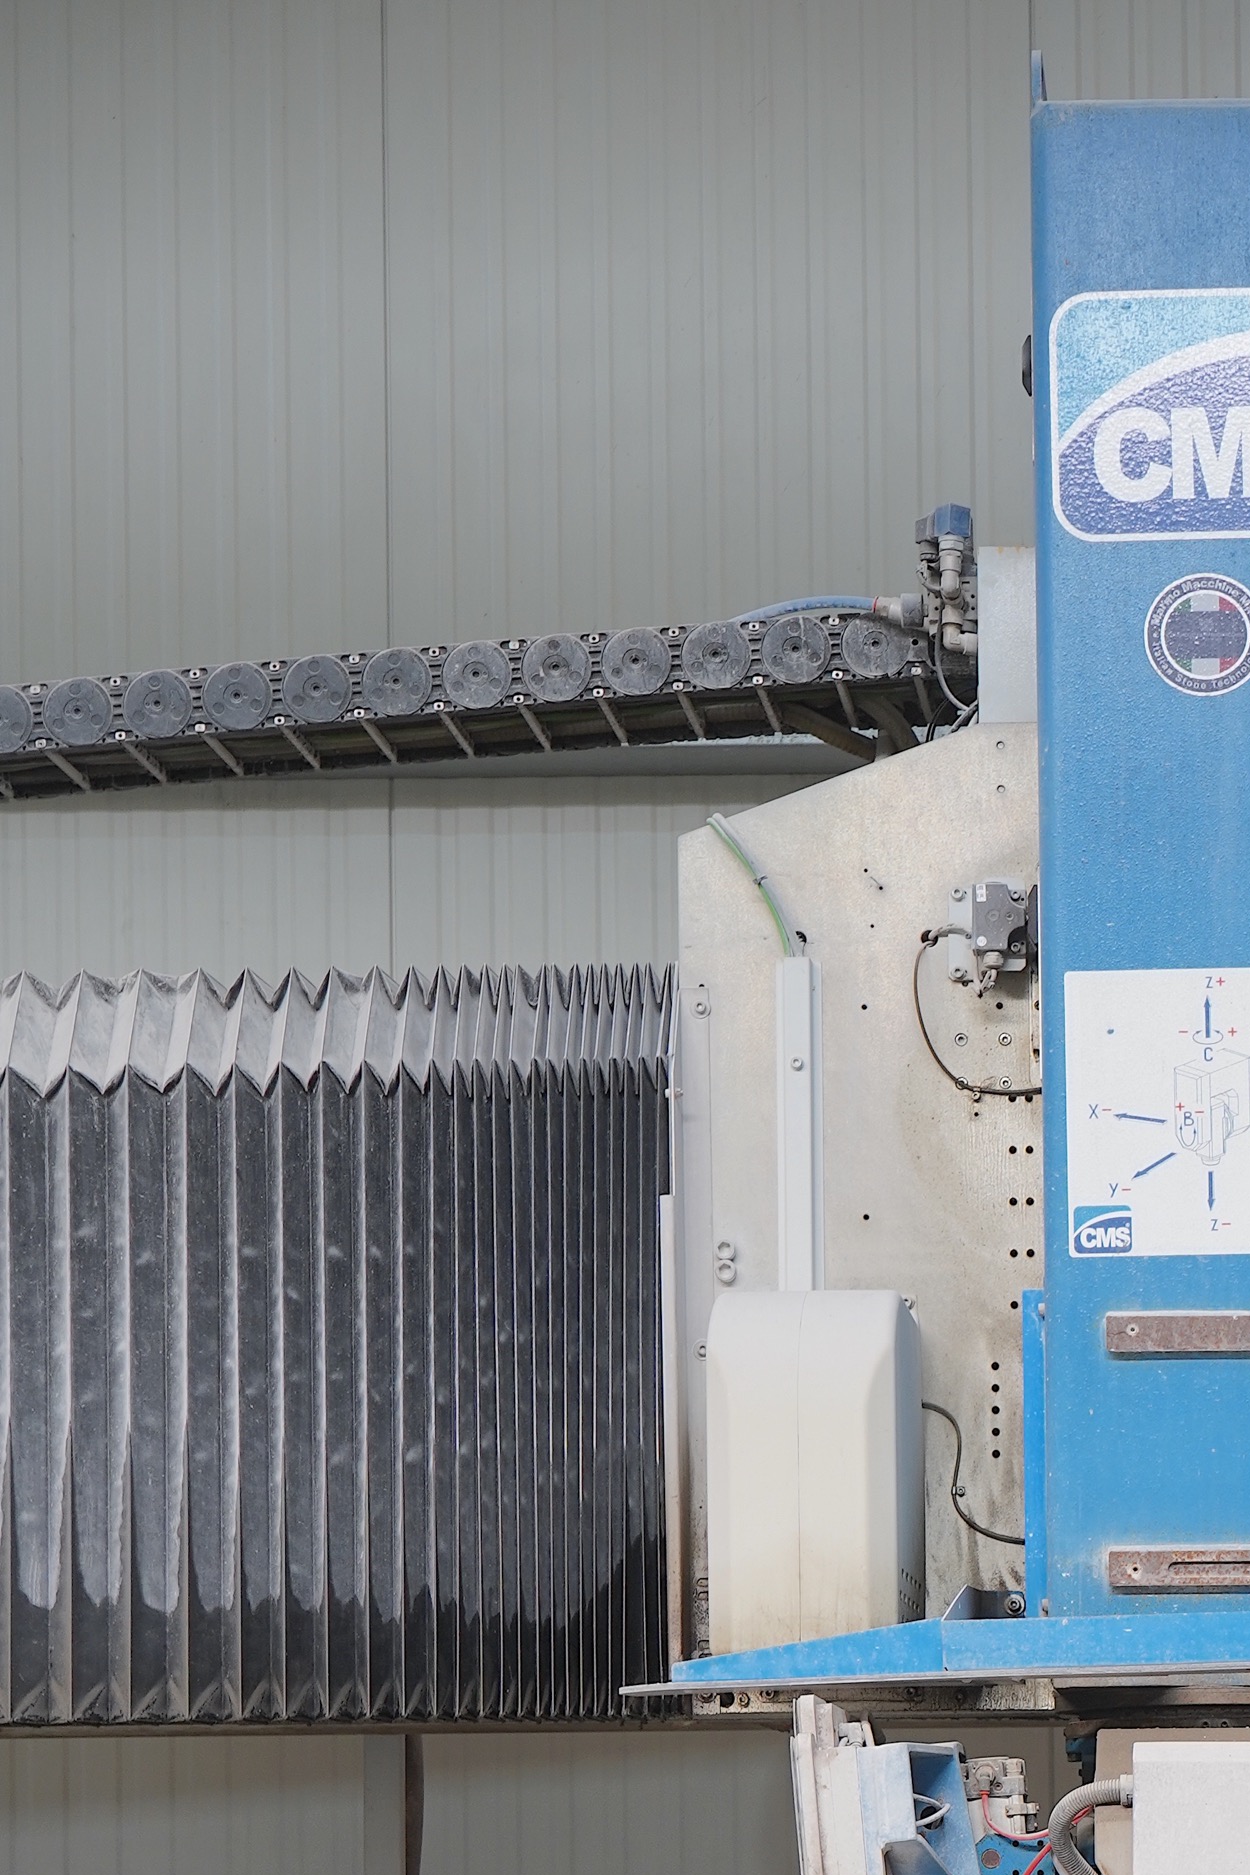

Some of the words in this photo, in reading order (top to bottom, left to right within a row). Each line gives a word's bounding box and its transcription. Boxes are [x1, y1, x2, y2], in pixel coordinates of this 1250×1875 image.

[1151, 590, 1180, 626] Marmo
[1181, 579, 1239, 597] Macchine
[1152, 642, 1174, 676] Italian
[1175, 673, 1207, 689] Stone
[1203, 1047, 1214, 1062] C
[1183, 1111, 1195, 1127] B
[1080, 1227, 1131, 1249] CMS
